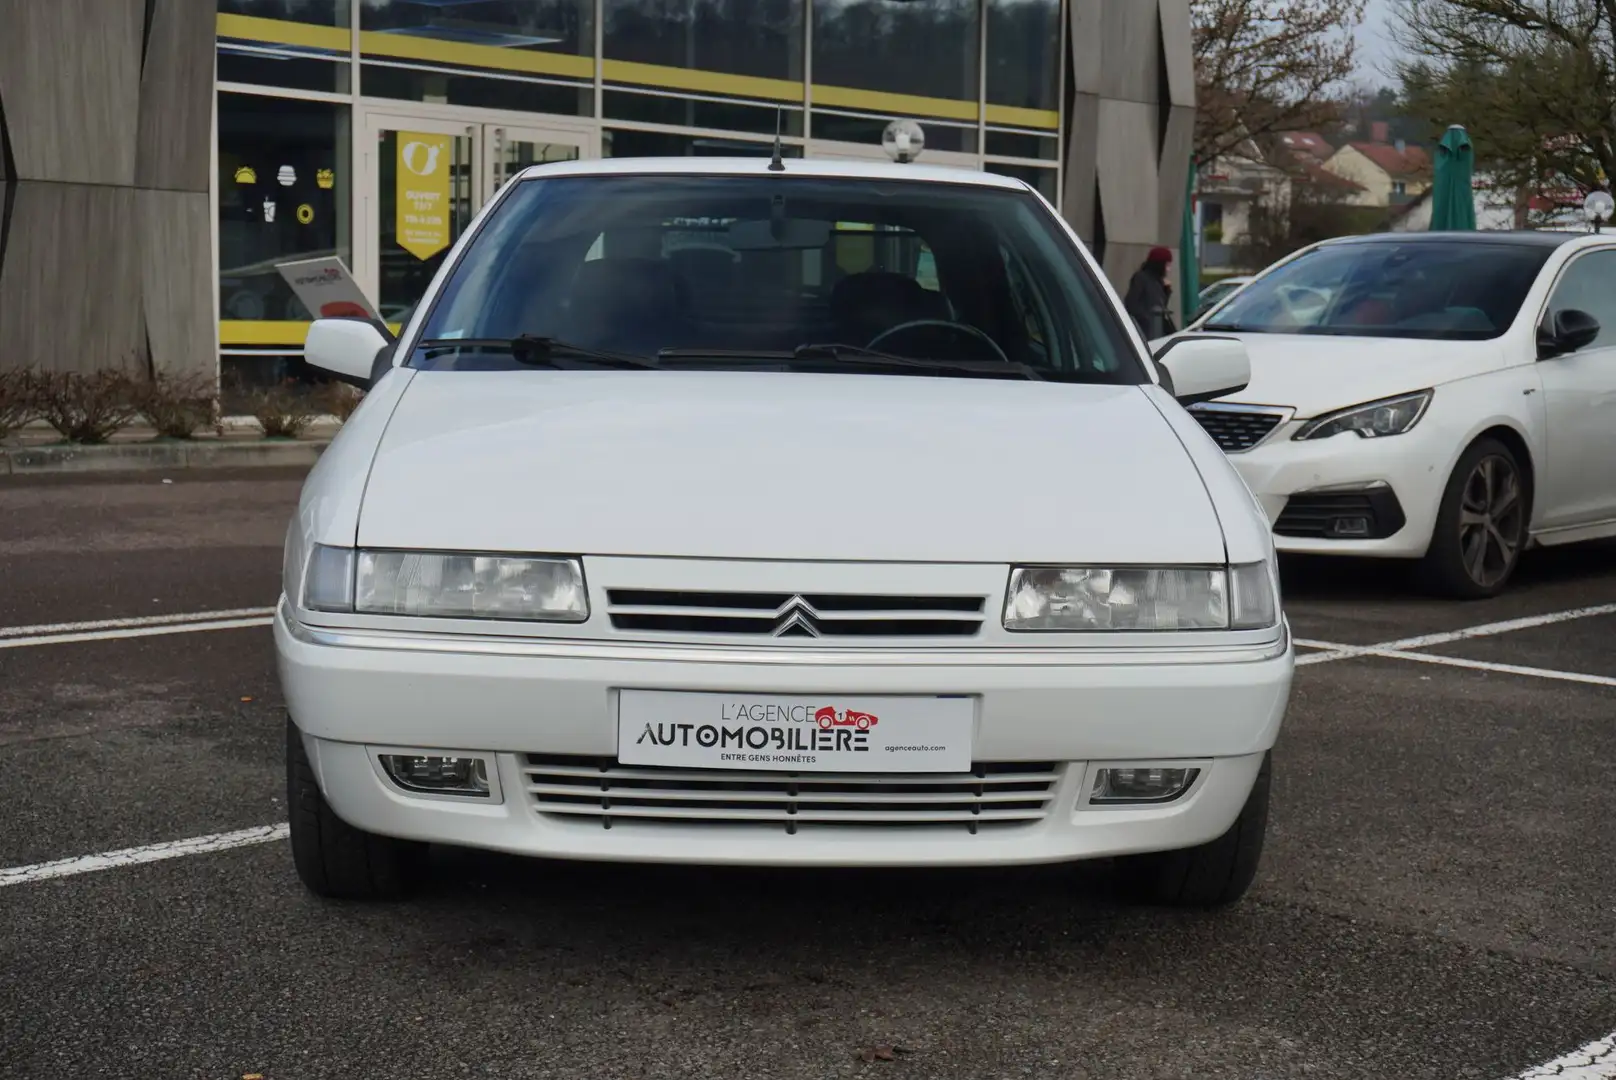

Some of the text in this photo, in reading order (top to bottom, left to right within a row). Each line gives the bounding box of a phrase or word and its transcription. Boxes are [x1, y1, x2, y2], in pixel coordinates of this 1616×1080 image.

[721, 703, 816, 722] L'AGENCE
[884, 744, 946, 753] agenceauto.com
[720, 753, 816, 763] ENTRE GENS HONNÊTES
